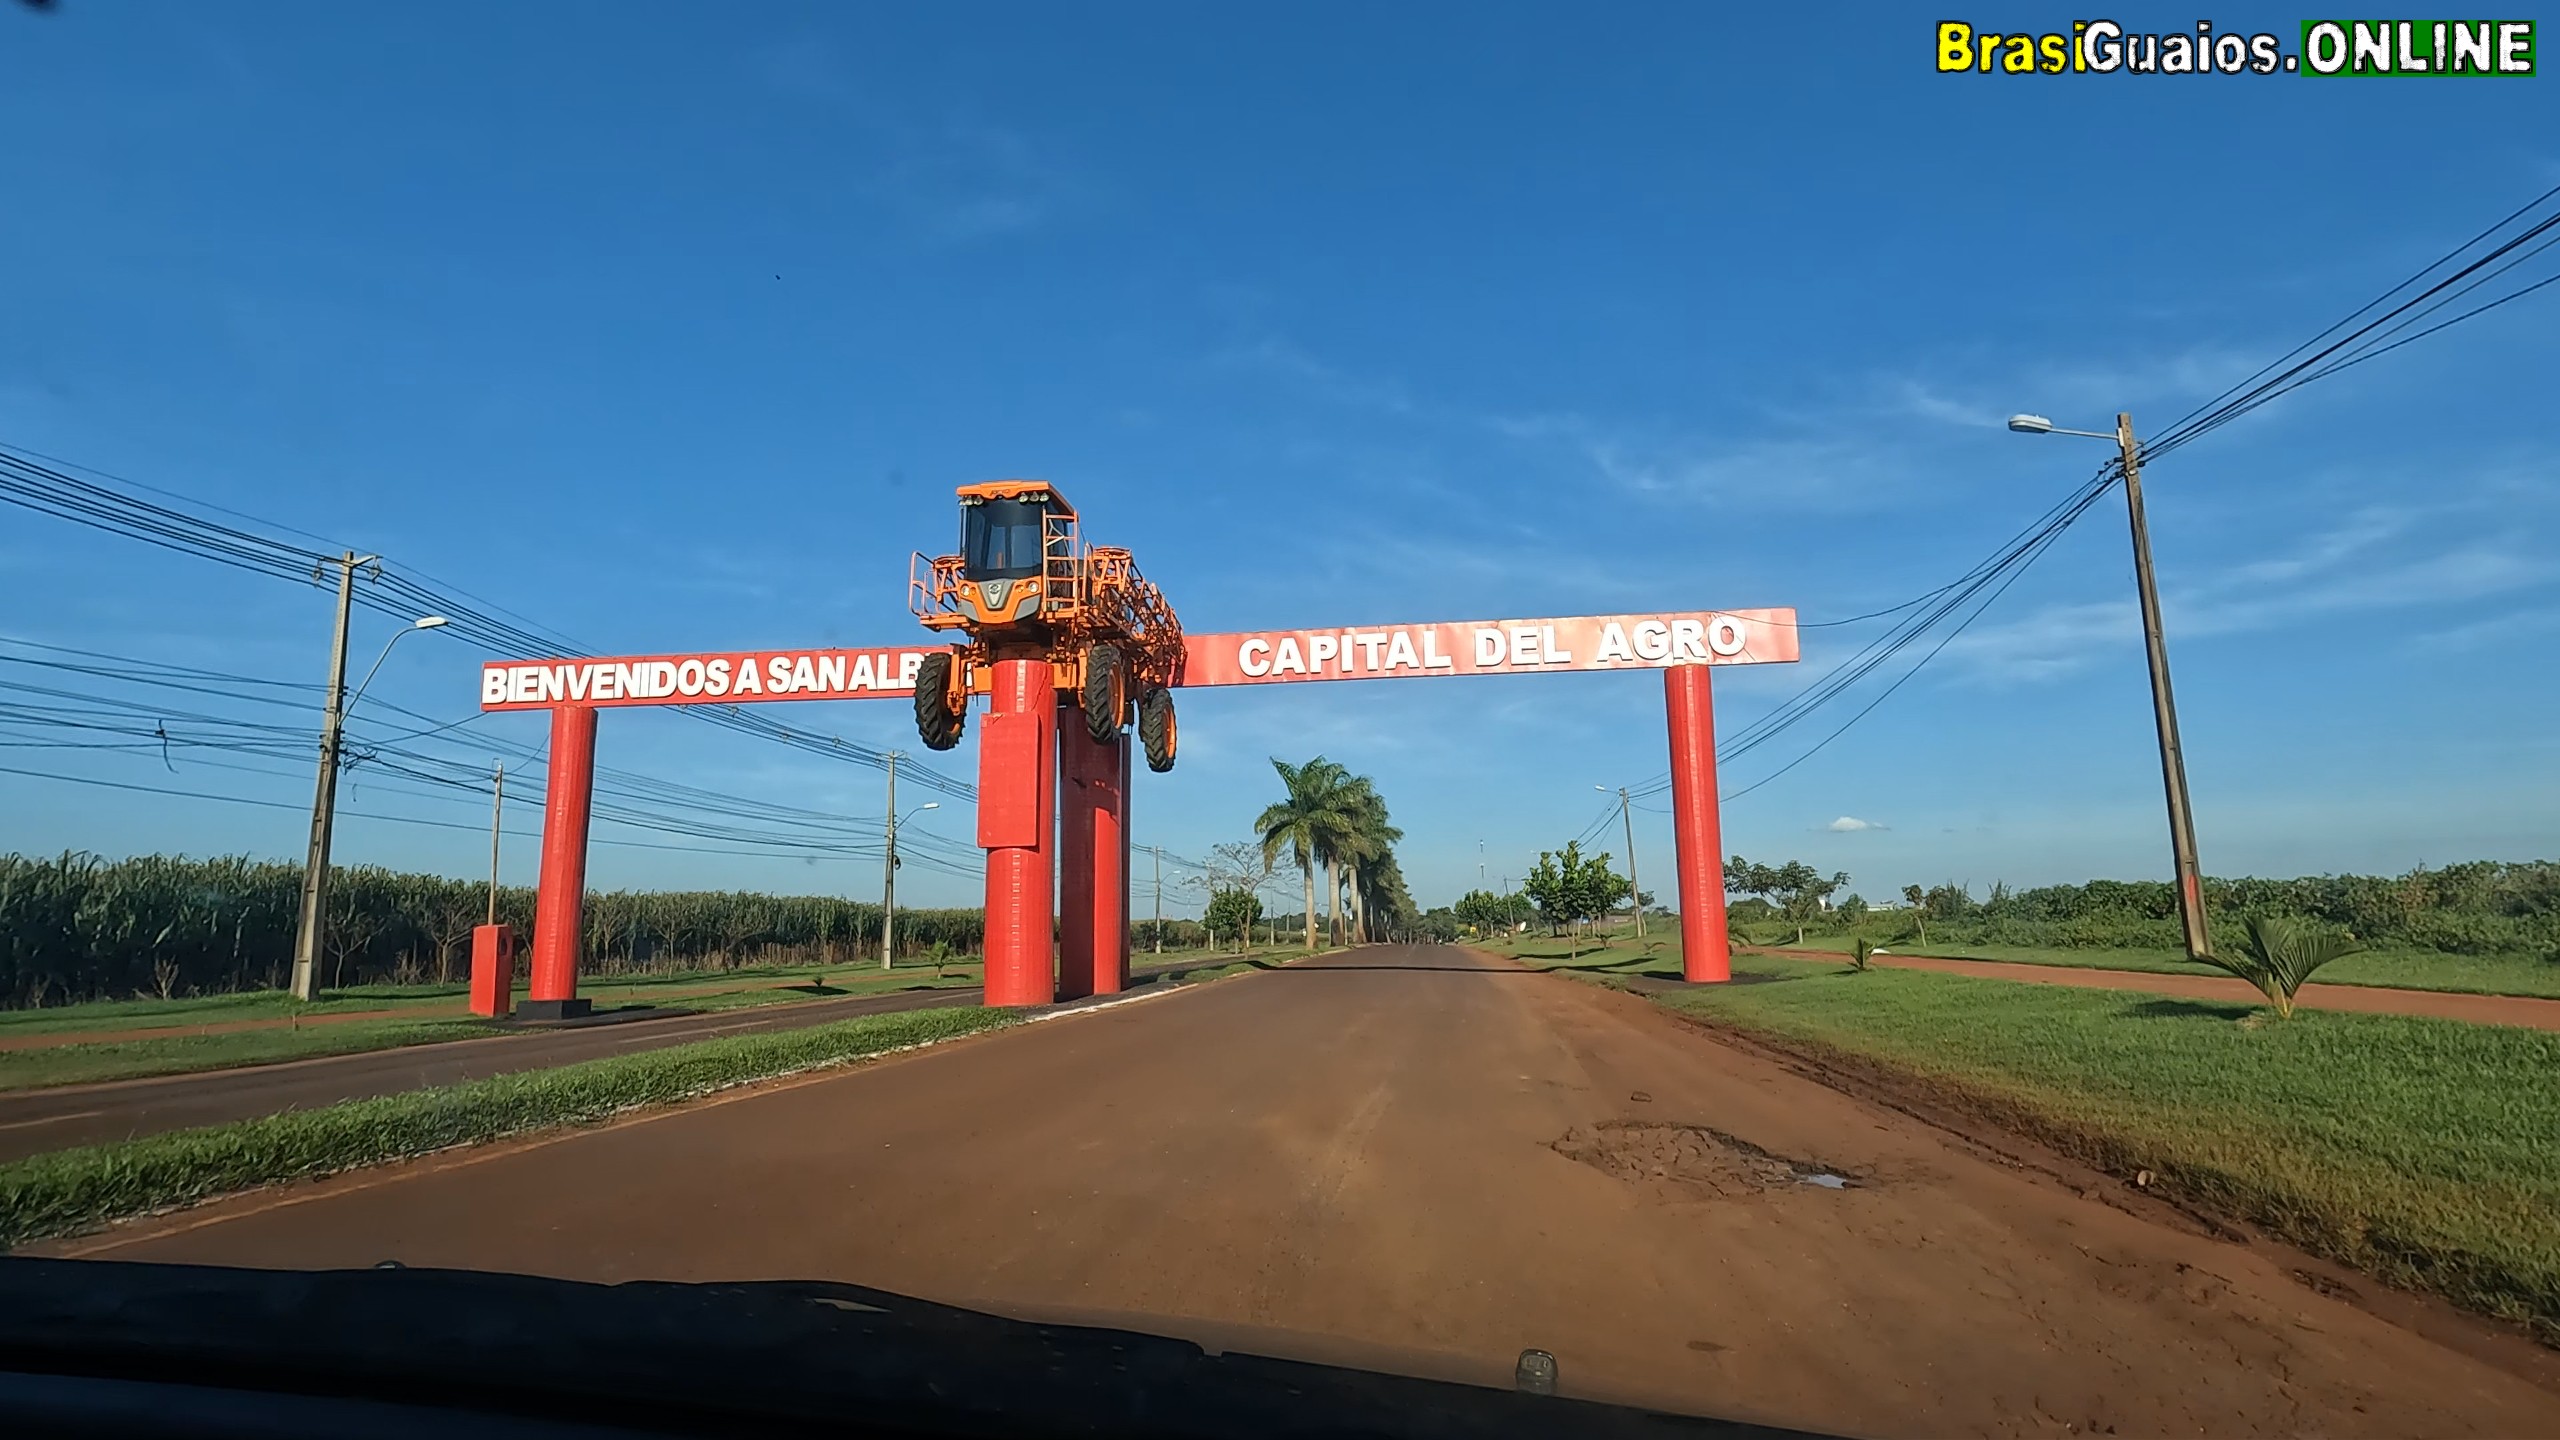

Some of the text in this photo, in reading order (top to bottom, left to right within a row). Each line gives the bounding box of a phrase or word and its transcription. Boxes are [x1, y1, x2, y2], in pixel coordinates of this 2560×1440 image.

[1238, 614, 1748, 677] CAPITAL DEL AGRO
[482, 658, 732, 704] BIENVENIDOS
[733, 658, 764, 695] A
[767, 655, 846, 692] SAN
